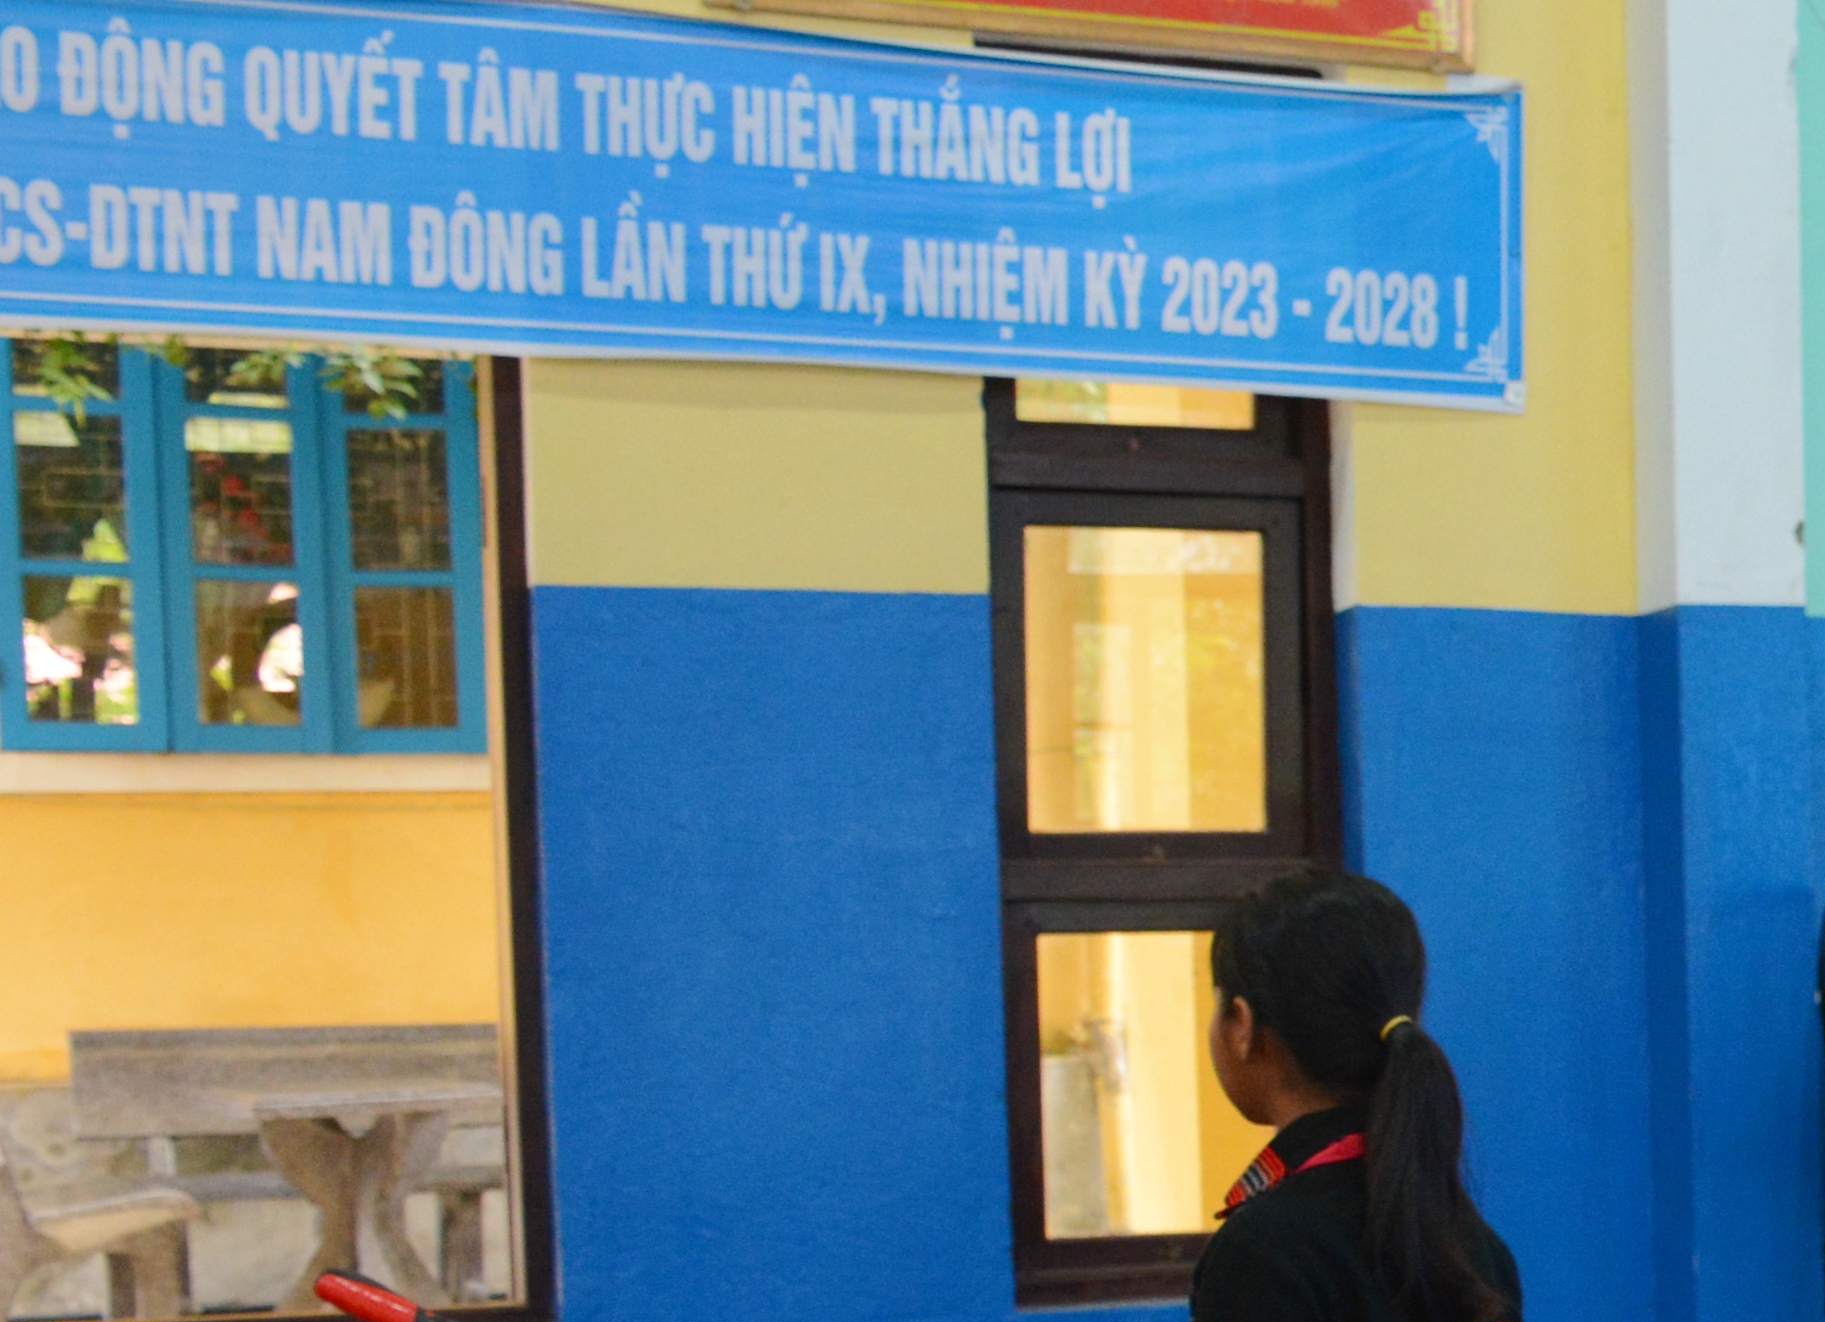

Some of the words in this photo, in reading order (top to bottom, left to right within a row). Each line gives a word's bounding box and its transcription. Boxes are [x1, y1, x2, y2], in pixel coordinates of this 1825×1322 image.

[57, 16, 225, 140] ĐỘNG
[243, 30, 424, 141] QUYẾT
[438, 47, 559, 152] TÂM
[575, 72, 716, 178] THỰC
[732, 73, 856, 188] HIỆN
[870, 74, 1040, 187] THẮNG
[1055, 107, 1132, 210] LỢI
[256, 194, 393, 286] NAM
[407, 189, 564, 296] ĐÔNG
[581, 190, 687, 303] LẦN
[701, 213, 810, 310] THỨ
[819, 232, 887, 325] IX,
[903, 227, 1070, 341] NHIỆM
[1083, 235, 1148, 331] KỲ
[1161, 255, 1279, 340] 2023
[1325, 267, 1438, 350] 2028
